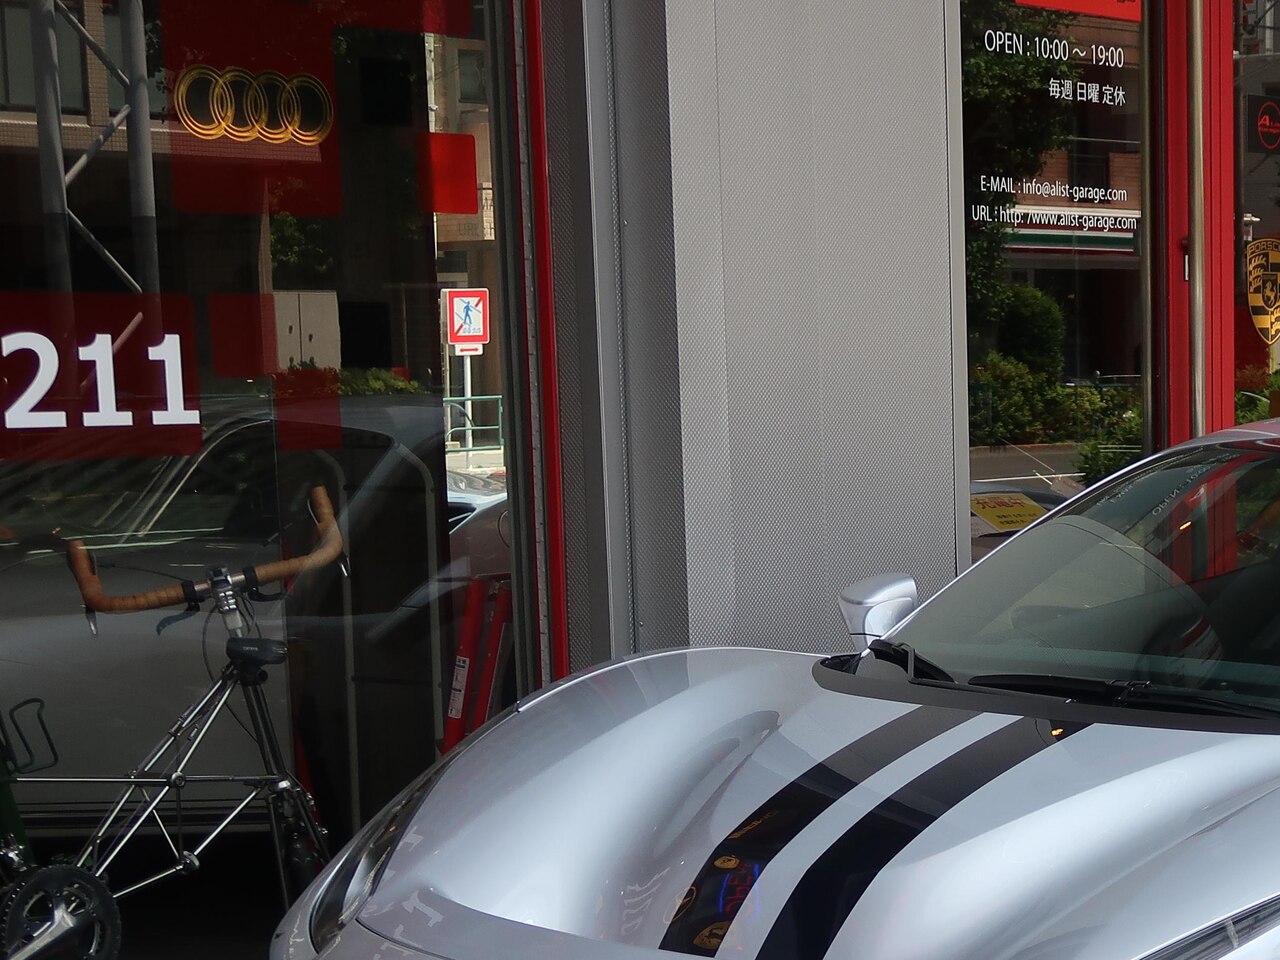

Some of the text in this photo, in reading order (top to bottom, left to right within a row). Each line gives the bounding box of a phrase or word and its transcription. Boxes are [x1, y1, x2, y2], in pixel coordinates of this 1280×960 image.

[984, 29, 1024, 56] OPEN
[1034, 36, 1069, 61] 10:00
[1091, 44, 1124, 68] 19:00
[980, 175, 1015, 194] E-MAIL
[1023, 178, 1128, 203] info@alist-garage.com
[972, 205, 992, 222] URL
[1000, 205, 1137, 231] http:/www.alist-garage.com
[1, 332, 201, 429] 211
